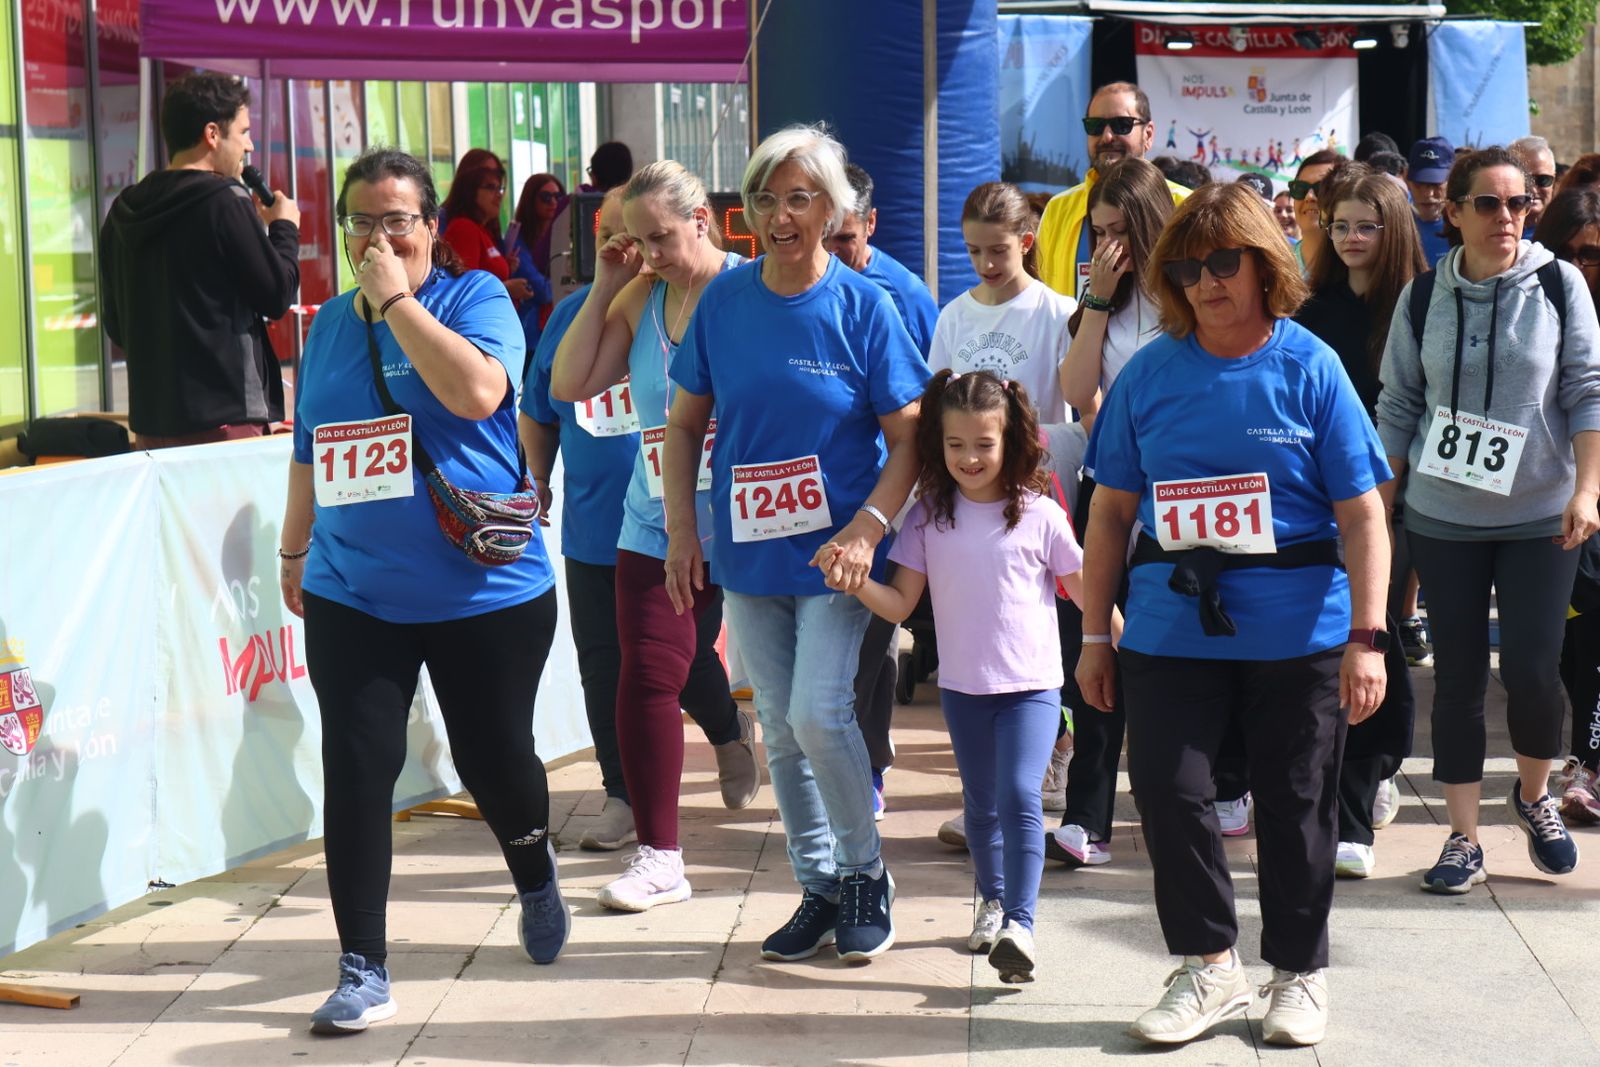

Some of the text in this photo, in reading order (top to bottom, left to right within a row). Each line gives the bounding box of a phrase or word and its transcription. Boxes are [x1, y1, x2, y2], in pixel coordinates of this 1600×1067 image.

[1182, 74, 1204, 84] NOS
[1270, 92, 1311, 102] Junta de
[1243, 104, 1278, 114] Castilla
[1288, 103, 1312, 114] León
[788, 358, 822, 367] CASTILLA
[825, 361, 831, 369] Y
[318, 429, 333, 439] DÍA
[335, 429, 345, 438] DE
[346, 425, 381, 437] CASTILLA
[387, 420, 407, 431] LEÓN
[1246, 428, 1284, 436] CASTILLA
[1438, 410, 1450, 420] DÍA
[1462, 417, 1496, 431] CASTILLA
[1503, 426, 1525, 439] LEÓN
[644, 432, 656, 441] DÍA
[1437, 424, 1509, 472] 813
[320, 438, 408, 482] 1123
[753, 468, 785, 478] CASTILLA
[792, 461, 814, 472] LEÓN
[1159, 486, 1175, 497] DÍA
[1177, 487, 1189, 496] DE
[1190, 483, 1230, 494] CASTILLA
[1239, 479, 1263, 490] LEÓN
[735, 478, 822, 520] 1246
[1162, 498, 1262, 541] 1181
